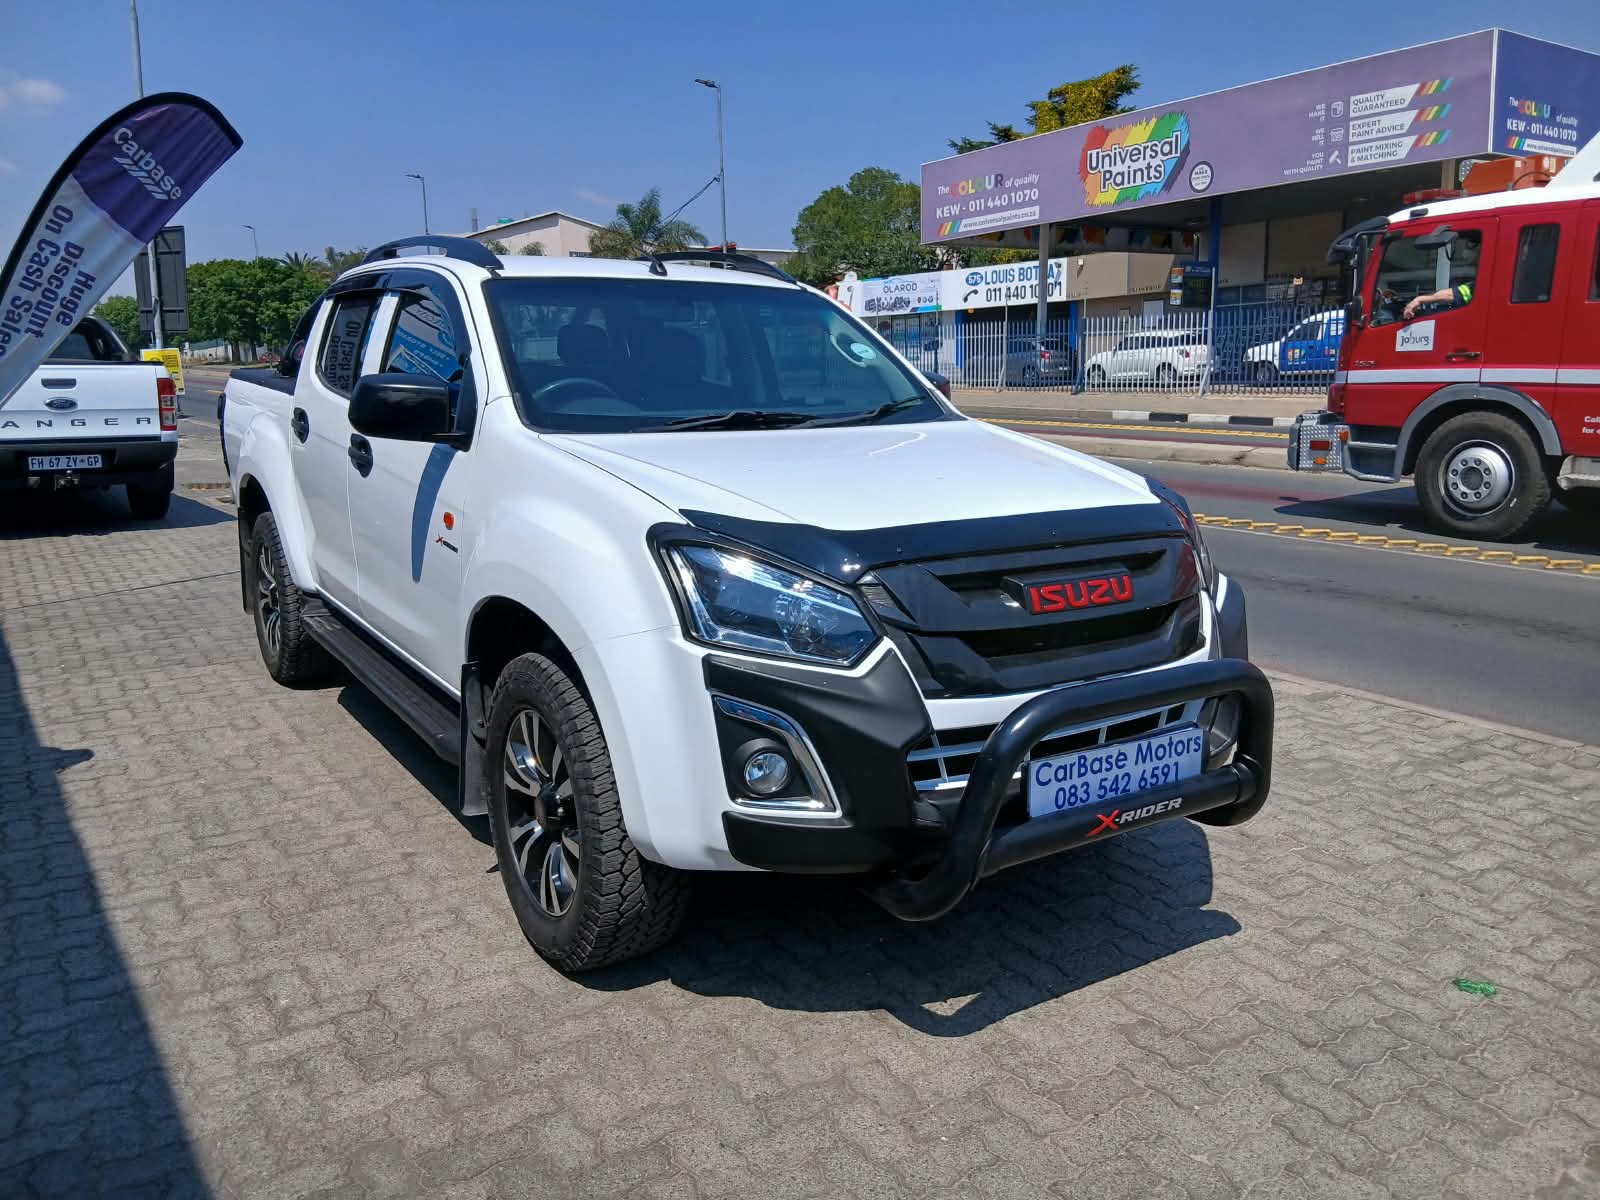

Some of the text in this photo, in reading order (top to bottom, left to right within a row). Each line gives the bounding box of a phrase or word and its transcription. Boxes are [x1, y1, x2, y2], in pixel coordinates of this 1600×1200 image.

[1352, 94, 1384, 106] QUALITY
[1352, 98, 1406, 113] GUARANTEED
[1509, 96, 1519, 107] The
[1518, 99, 1554, 119] COLOU
[1308, 110, 1326, 118] MAKE
[1351, 120, 1381, 130] EXPERT
[1351, 123, 1406, 139] PAINT ADVICE
[1506, 118, 1526, 132] KEW
[1531, 123, 1543, 135] 011
[1544, 126, 1558, 138] 440
[1559, 129, 1577, 142] 1070
[1087, 132, 1180, 173] Universal
[1350, 141, 1404, 155] PAINT MIXING
[1356, 150, 1398, 161] MATCHING
[114, 127, 182, 200] Carbase
[1283, 164, 1323, 176] WITH QUALITY
[937, 172, 1040, 197] The COLOUR of quality
[1101, 161, 1164, 191] Paints
[936, 203, 961, 219] KEW
[968, 198, 985, 212] 011
[987, 195, 1009, 209] 440
[1010, 188, 1039, 205] 1070
[45, 204, 74, 234] On
[18, 238, 61, 292] Cash
[968, 263, 1055, 285] 575 LOUIS BOTA
[24, 241, 85, 339] Discount
[55, 270, 97, 327] Huge
[986, 287, 1002, 302] 011
[1005, 285, 1027, 300] 440
[1582, 426, 1594, 434] for
[31, 456, 100, 468] FH 67 ZY GP
[1029, 574, 1133, 614] ISUZU
[1035, 734, 1202, 787] CarBase Motors
[1054, 761, 1181, 810] 083 542 6591
[1087, 797, 1183, 837] X-RIDER
